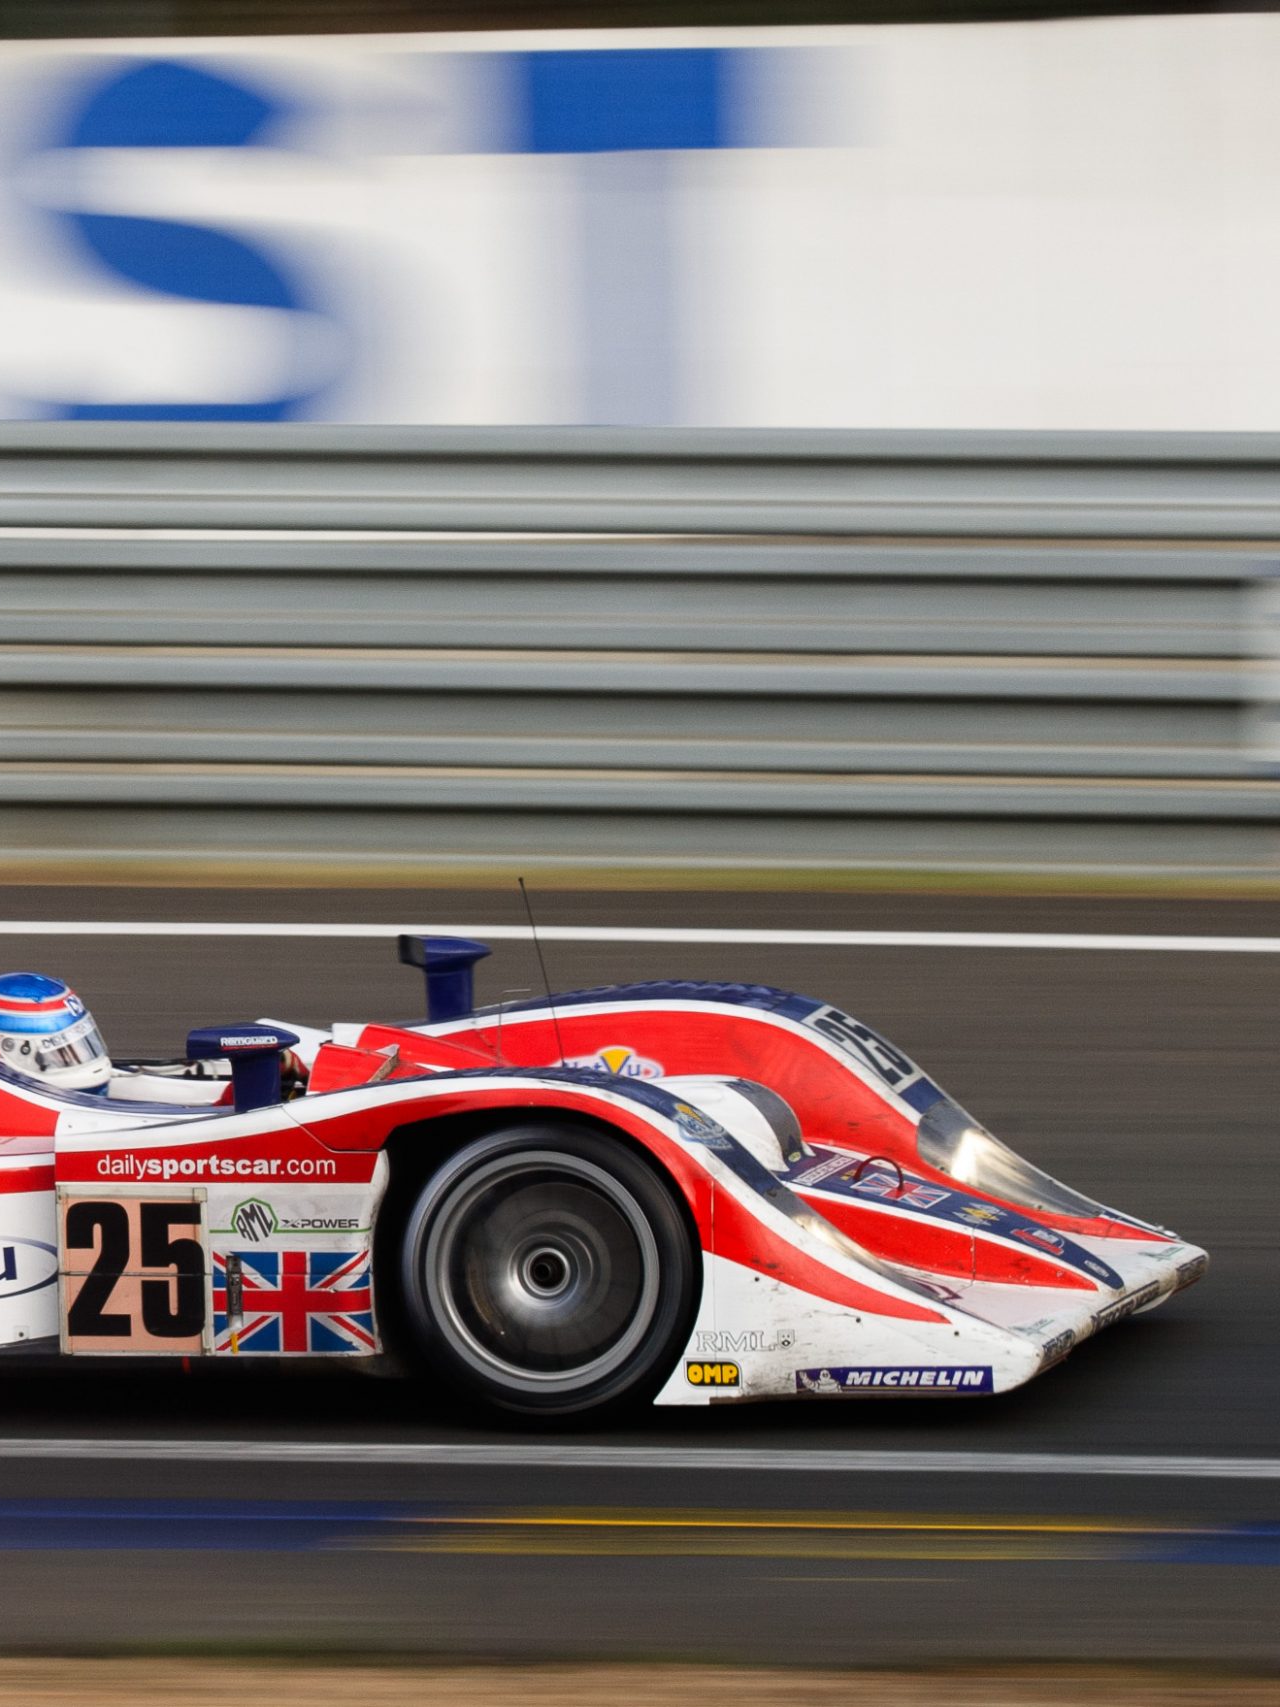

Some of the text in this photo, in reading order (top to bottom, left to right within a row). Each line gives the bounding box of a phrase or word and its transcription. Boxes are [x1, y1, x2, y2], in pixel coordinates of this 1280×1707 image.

[812, 1009, 915, 1086] 25
[96, 1154, 337, 1180] dailysportscar.com
[66, 1202, 205, 1338] 25
[687, 1363, 738, 1384] OMP
[845, 1370, 984, 1386] MICHELIN
